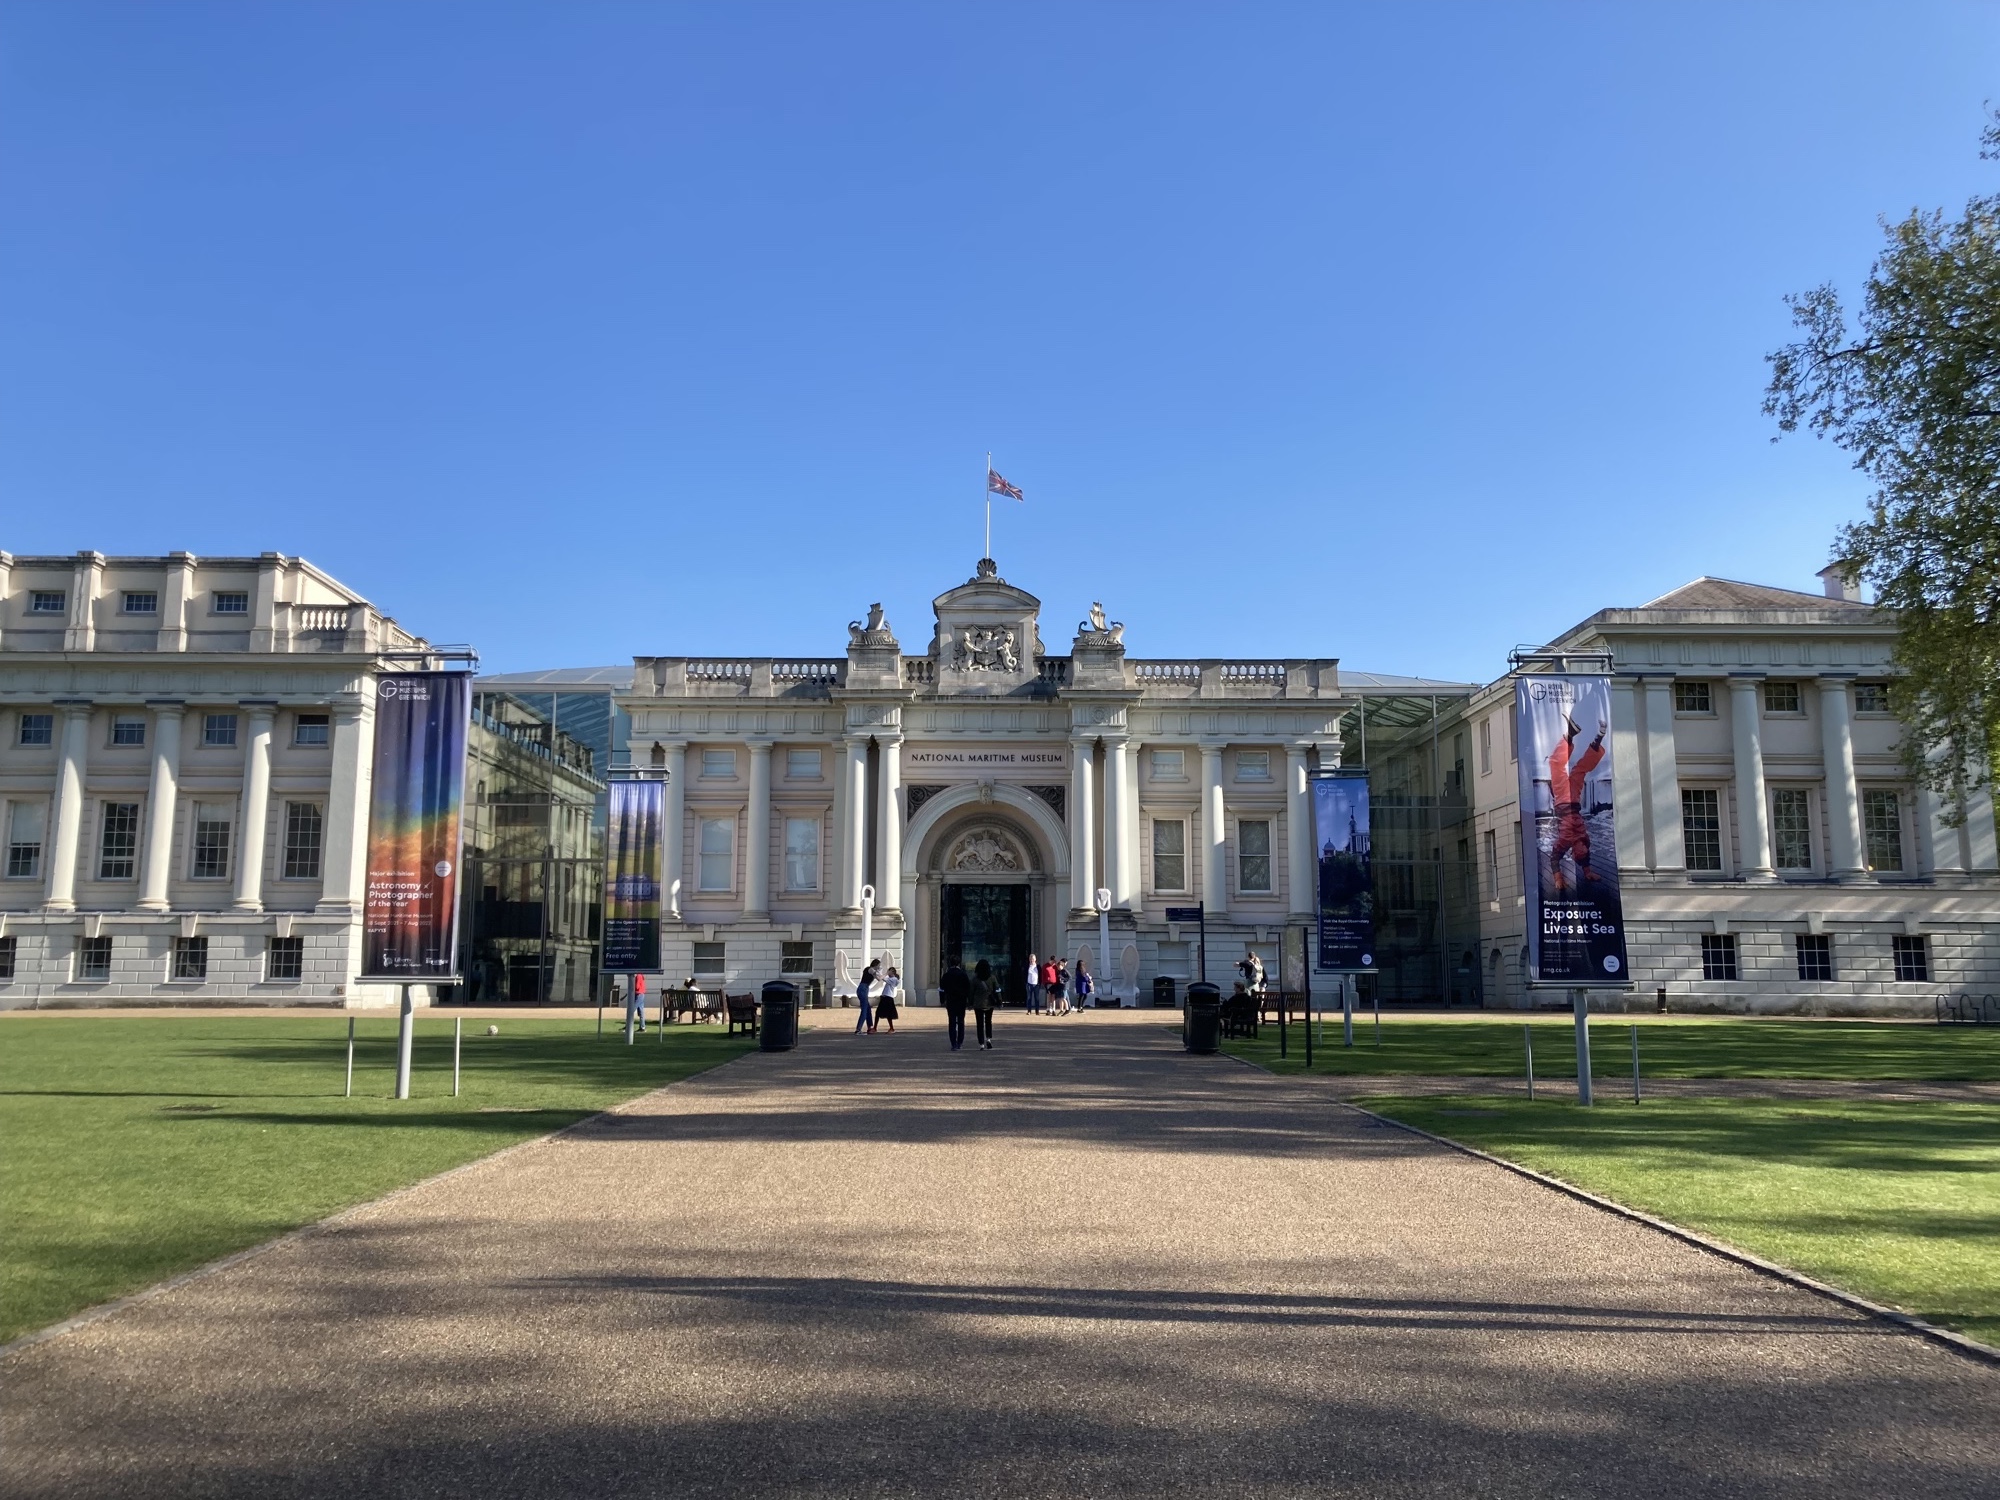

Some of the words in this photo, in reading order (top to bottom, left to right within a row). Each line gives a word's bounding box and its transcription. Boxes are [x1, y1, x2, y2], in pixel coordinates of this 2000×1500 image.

[912, 753, 965, 762] NATIONAL
[968, 754, 1015, 762] MARITIME
[1021, 754, 1062, 762] MUSEUM
[369, 882, 421, 891] Astronomy
[369, 891, 434, 900] Photographer
[1544, 908, 1602, 921] Exposure:
[1544, 922, 1574, 934] Lives
[1576, 924, 1588, 934] at
[1592, 923, 1615, 934] Sea
